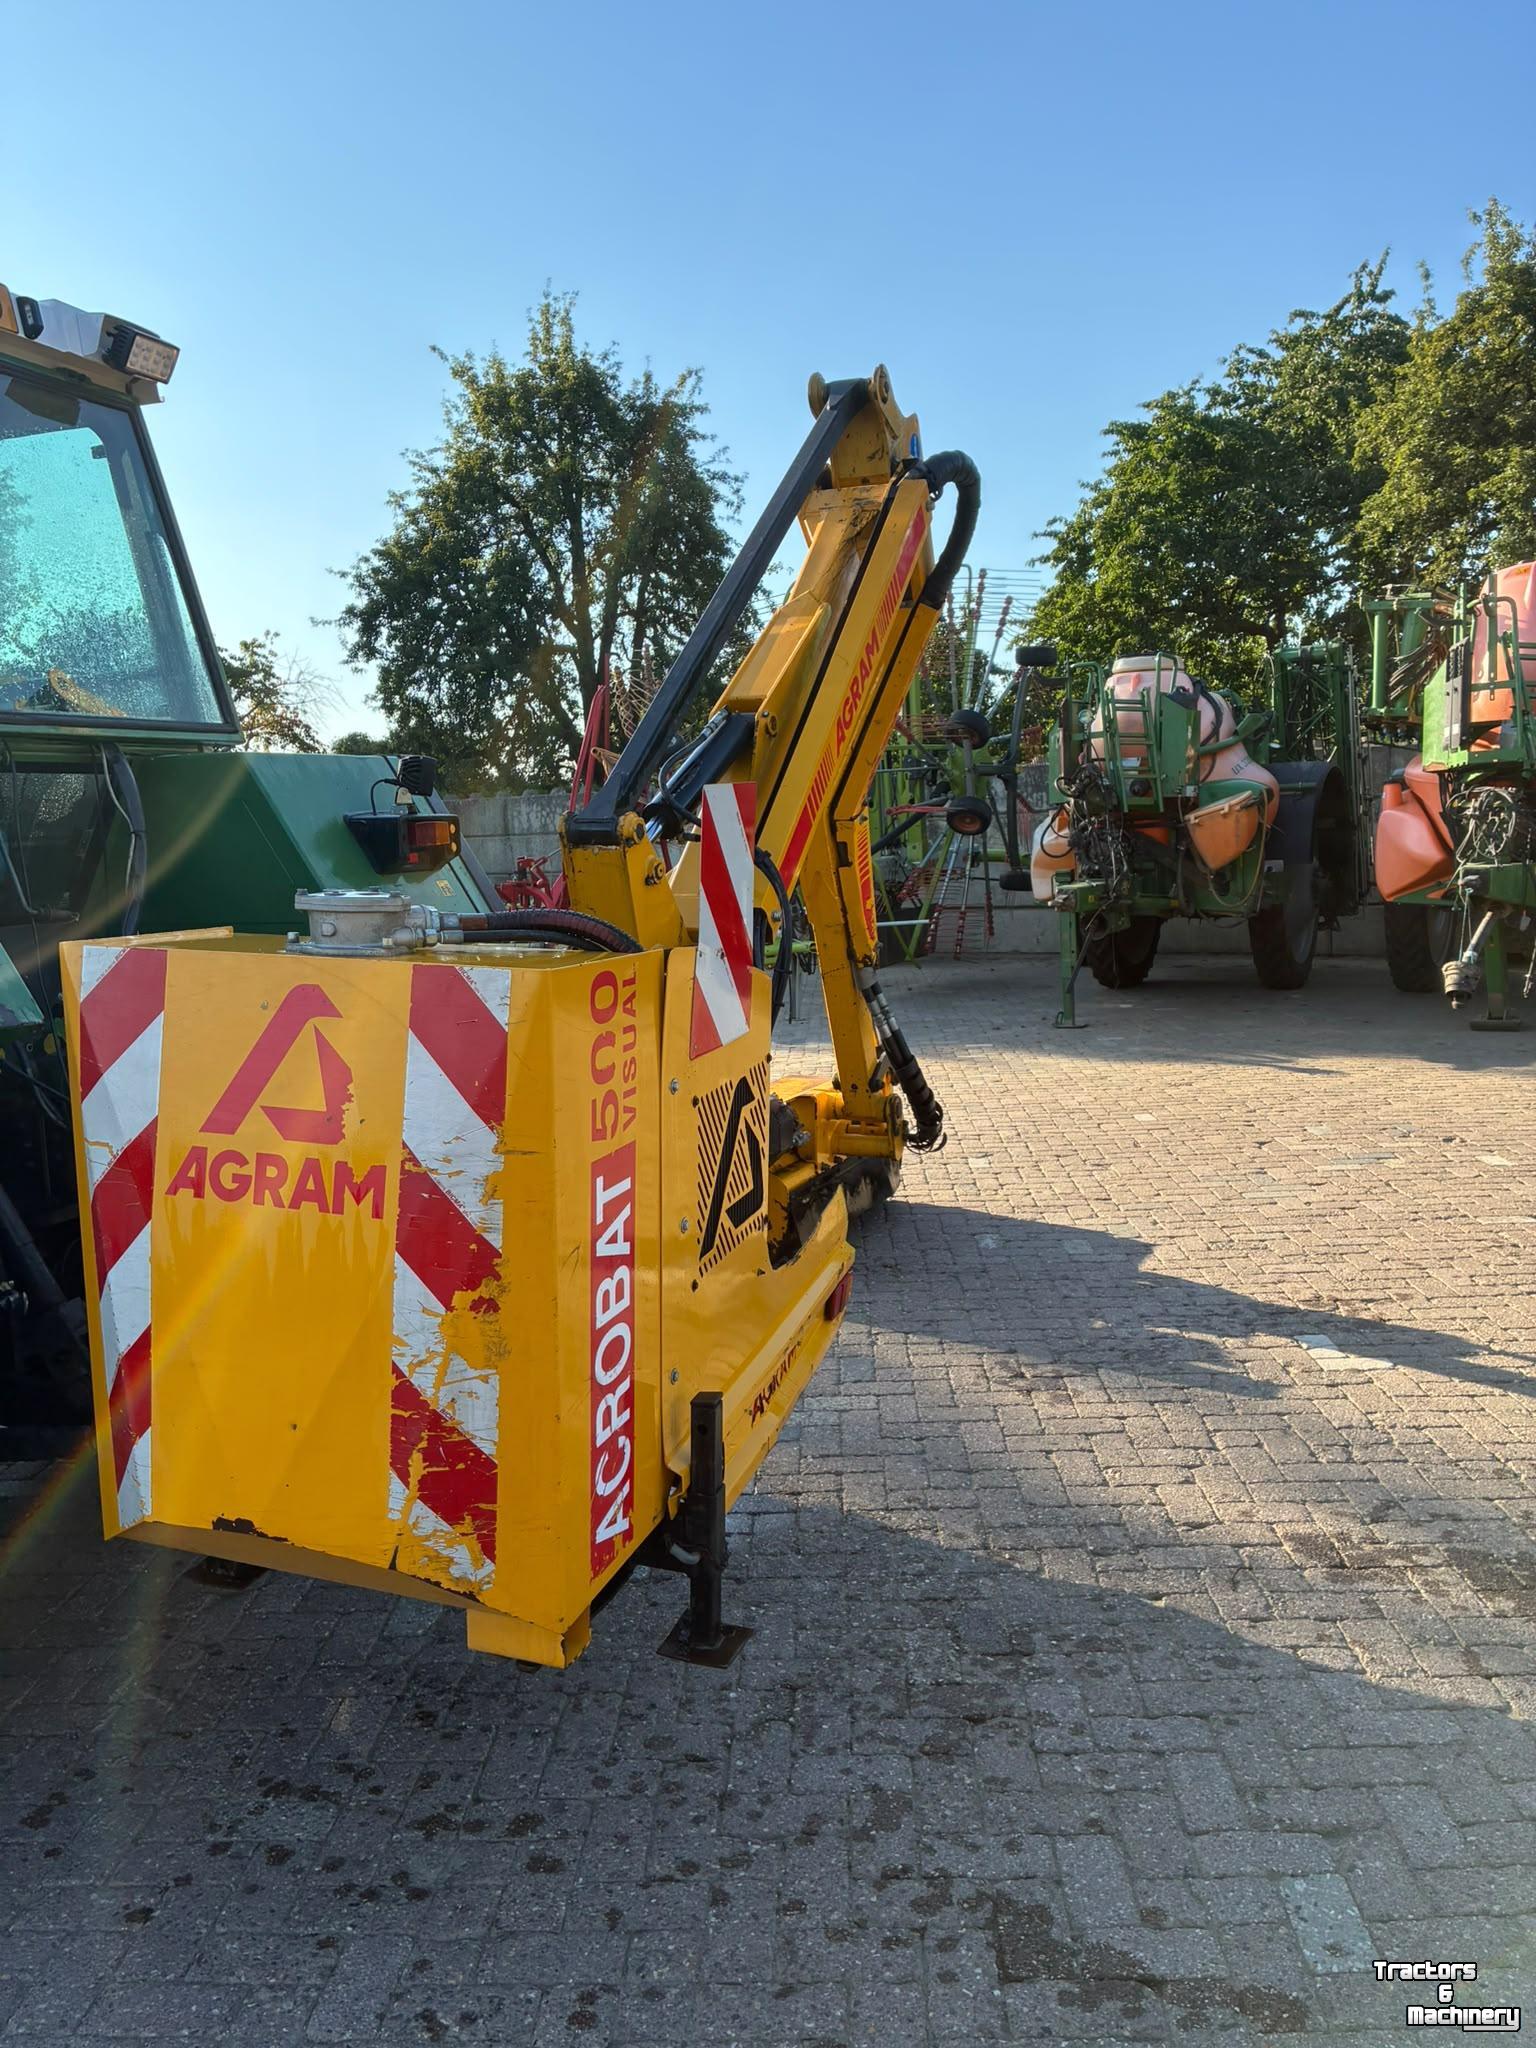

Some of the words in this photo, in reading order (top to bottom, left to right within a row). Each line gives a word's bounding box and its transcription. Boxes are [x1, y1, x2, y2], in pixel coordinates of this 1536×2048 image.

[835, 632, 880, 758] AGRAM
[590, 970, 619, 1142] 500
[622, 964, 637, 1133] VISUAL
[165, 1145, 387, 1219] AGRAM
[595, 1175, 632, 1545] ACROBAT
